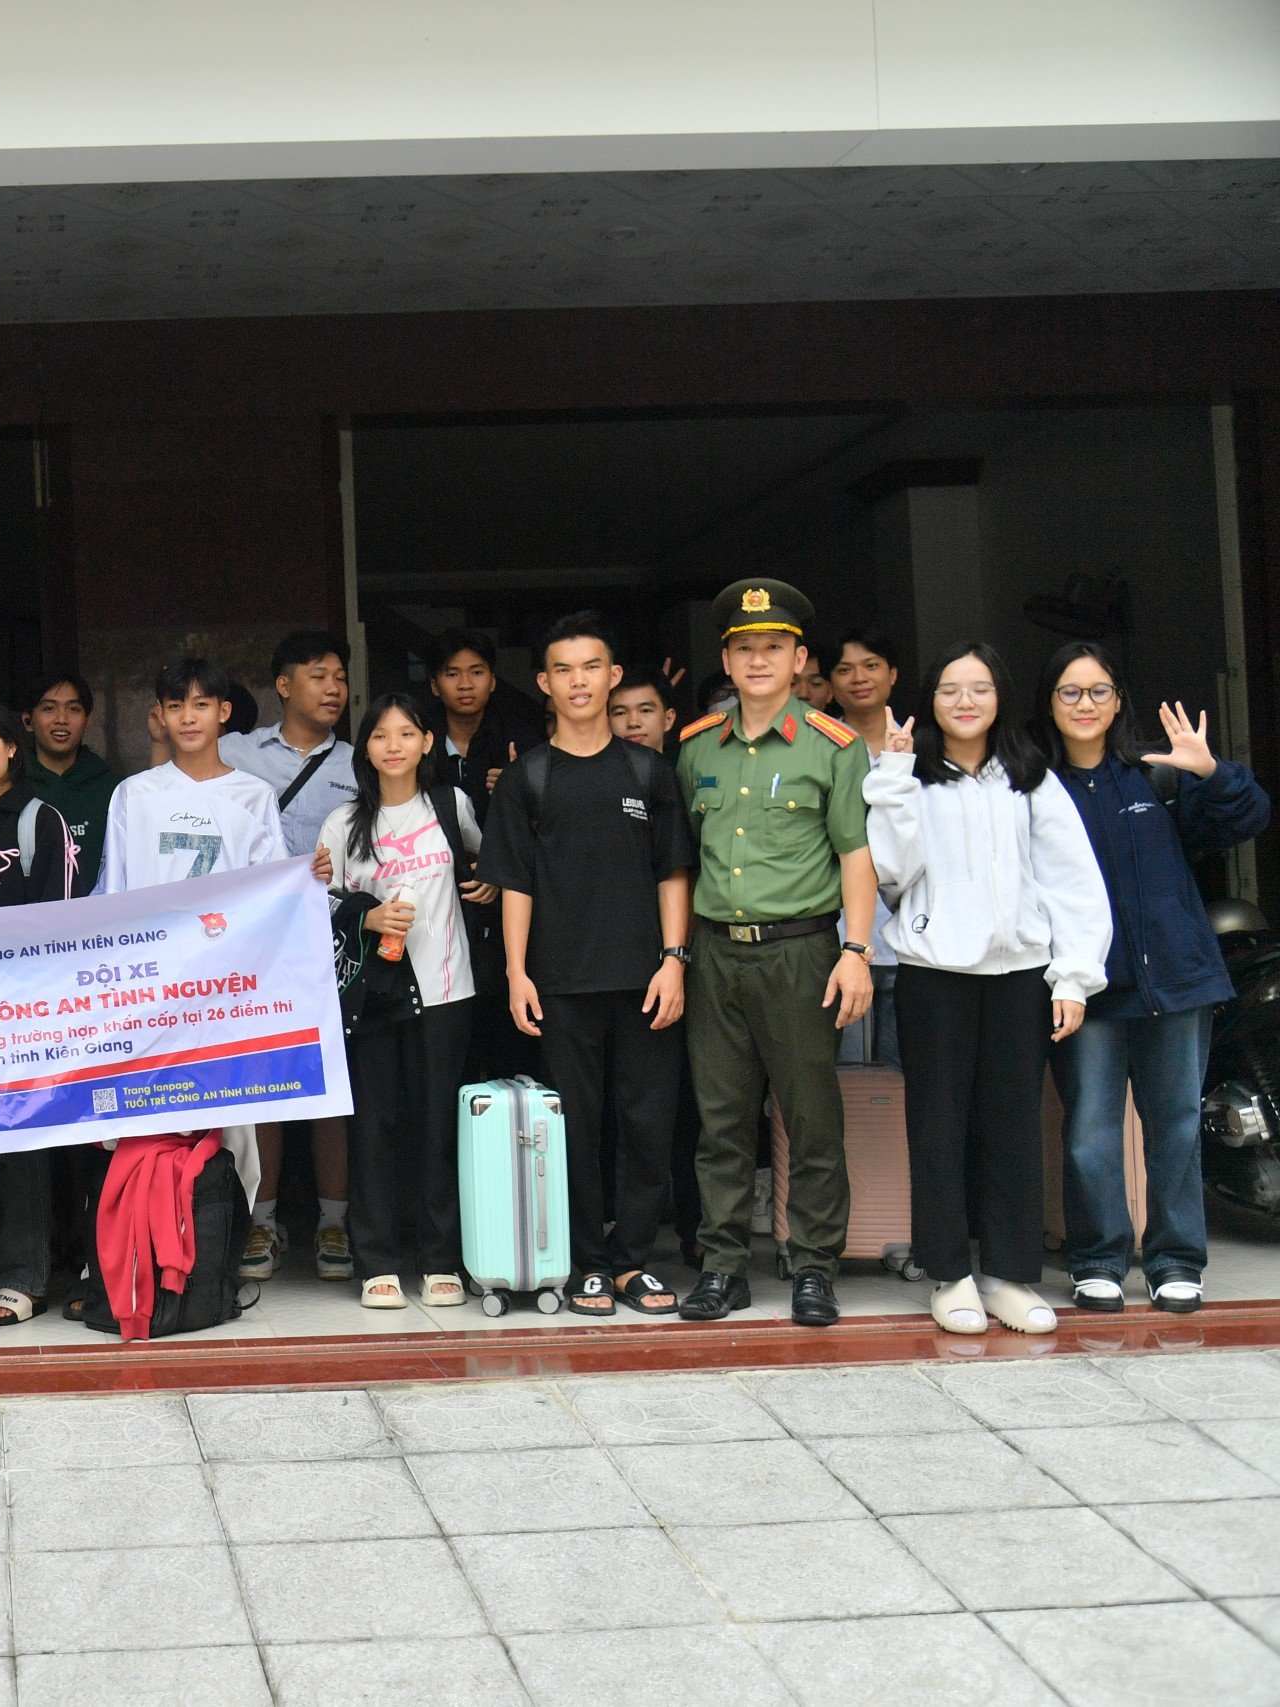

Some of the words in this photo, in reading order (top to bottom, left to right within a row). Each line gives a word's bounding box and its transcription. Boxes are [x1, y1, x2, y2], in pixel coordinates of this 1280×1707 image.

[159, 831, 222, 879] 7
[20, 945, 40, 958] AN
[44, 940, 77, 955] TỈNH
[82, 935, 114, 950] KIÊN
[118, 929, 168, 945] GIANG
[76, 963, 122, 988] ĐỘI
[128, 961, 160, 979] XE
[57, 995, 92, 1015] AN
[97, 986, 156, 1009] TÌNH
[163, 972, 258, 1000] NGUYỆN
[11, 1029, 63, 1045] trường
[68, 1025, 99, 1041] hợp
[103, 1014, 142, 1034] khẩn
[147, 1010, 178, 1031] cấp
[182, 1010, 203, 1027] tại
[207, 1007, 226, 1021] 26
[230, 1000, 268, 1018] điểm
[272, 999, 294, 1014] thi
[10, 1049, 40, 1064] tỉnh
[45, 1045, 80, 1060] Kiên
[84, 1039, 133, 1054] Giang
[122, 1085, 151, 1096] Trang
[153, 1081, 195, 1092] fanpage
[124, 1095, 147, 1109] TUỔI
[169, 1092, 200, 1104] CÔNG
[203, 1091, 218, 1101] AN
[245, 1083, 266, 1096] KIÊN
[268, 1081, 302, 1093] GIANG
[583, 1276, 602, 1294] G
